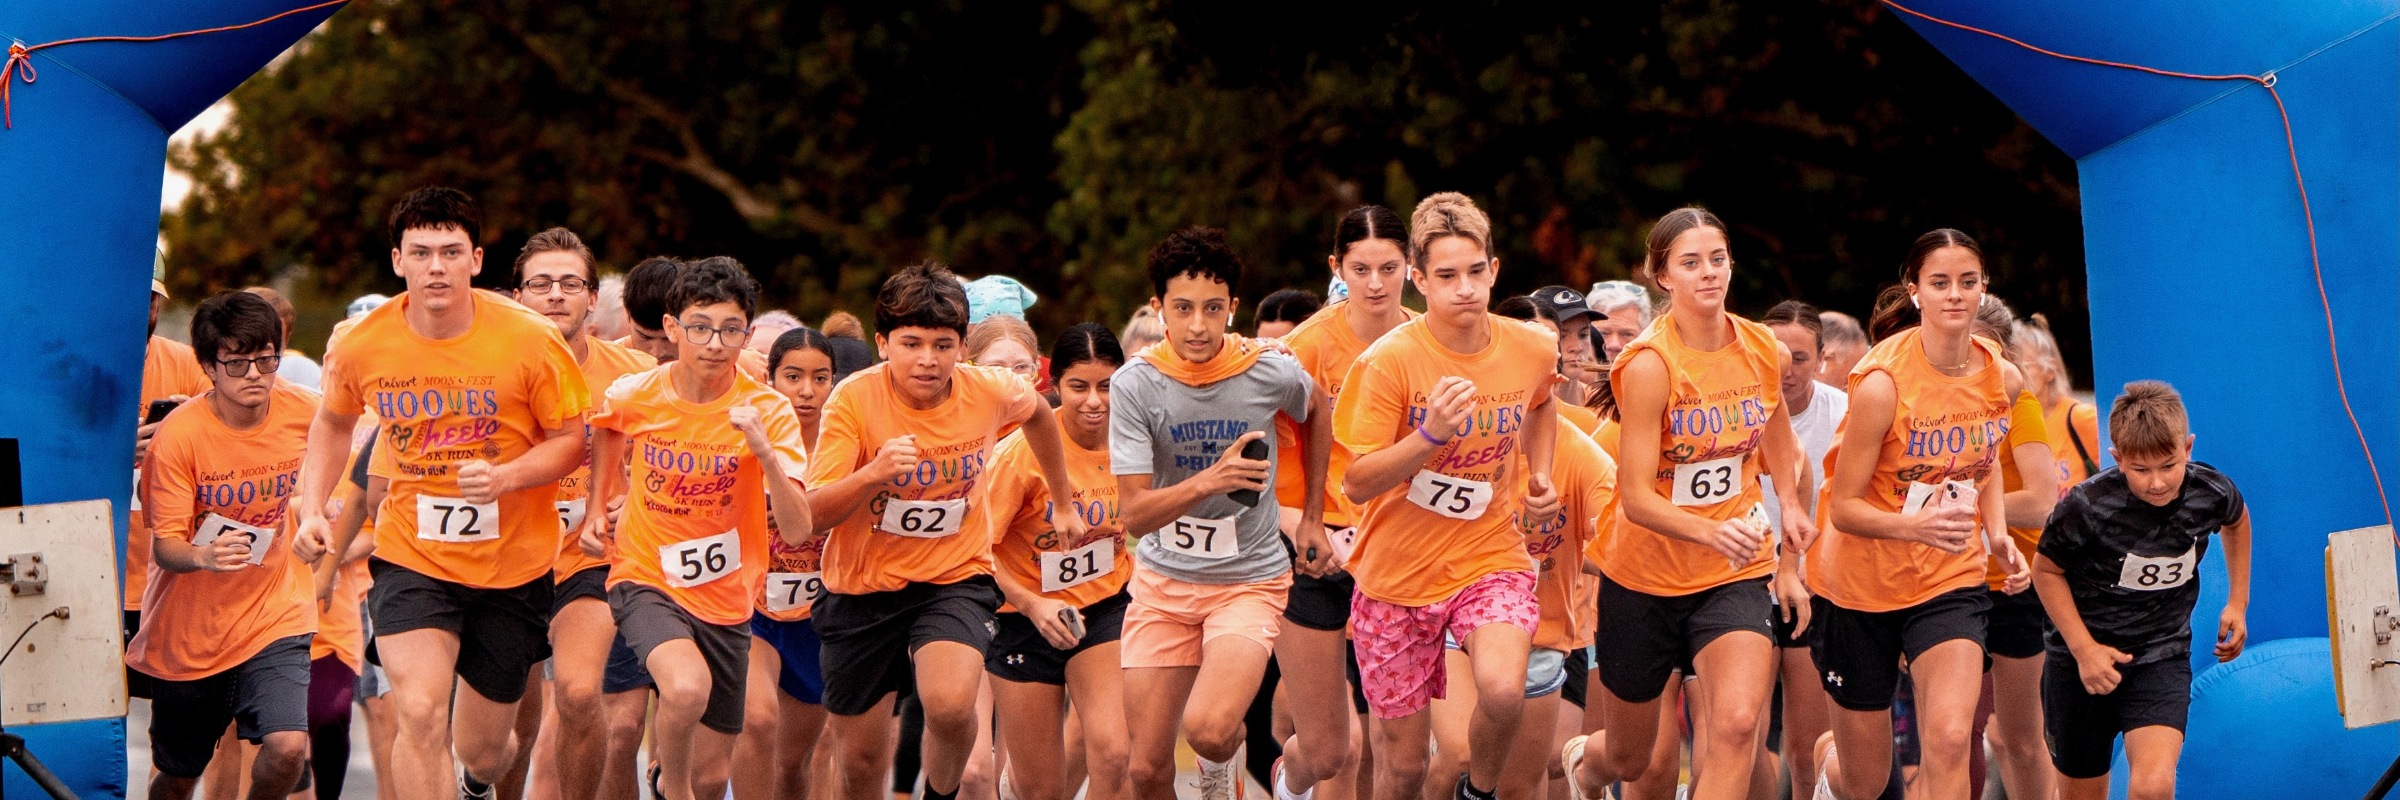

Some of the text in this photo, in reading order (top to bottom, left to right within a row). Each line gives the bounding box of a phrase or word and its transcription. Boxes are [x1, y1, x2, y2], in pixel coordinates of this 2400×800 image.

[378, 375, 496, 389] Calvert MOON FEST
[1708, 389, 1732, 403] MOON
[1740, 384, 1762, 397] FEST
[1499, 390, 1525, 403] FEST
[1912, 414, 1946, 429] Calvert
[1950, 411, 1980, 423] MOON
[389, 423, 413, 453] &
[647, 434, 741, 454] Calvert MOON FEST
[919, 436, 986, 457] MOON FEST
[425, 449, 477, 461] 5K RUN
[200, 458, 300, 482] Calvert MOON FEST
[427, 465, 446, 476] RUN
[645, 470, 666, 493] &
[1690, 466, 1732, 499] 63
[691, 499, 715, 507] RUN
[1429, 479, 1475, 513] 75
[433, 505, 481, 535] 72
[651, 502, 673, 515] COLOR
[674, 507, 691, 516] RUN
[901, 507, 946, 532] 62
[1175, 521, 1217, 552] 57
[681, 543, 726, 580] 56
[785, 558, 809, 568] RUN
[1059, 550, 1099, 583] 81
[2137, 562, 2184, 587] 83
[782, 577, 821, 605] 79
